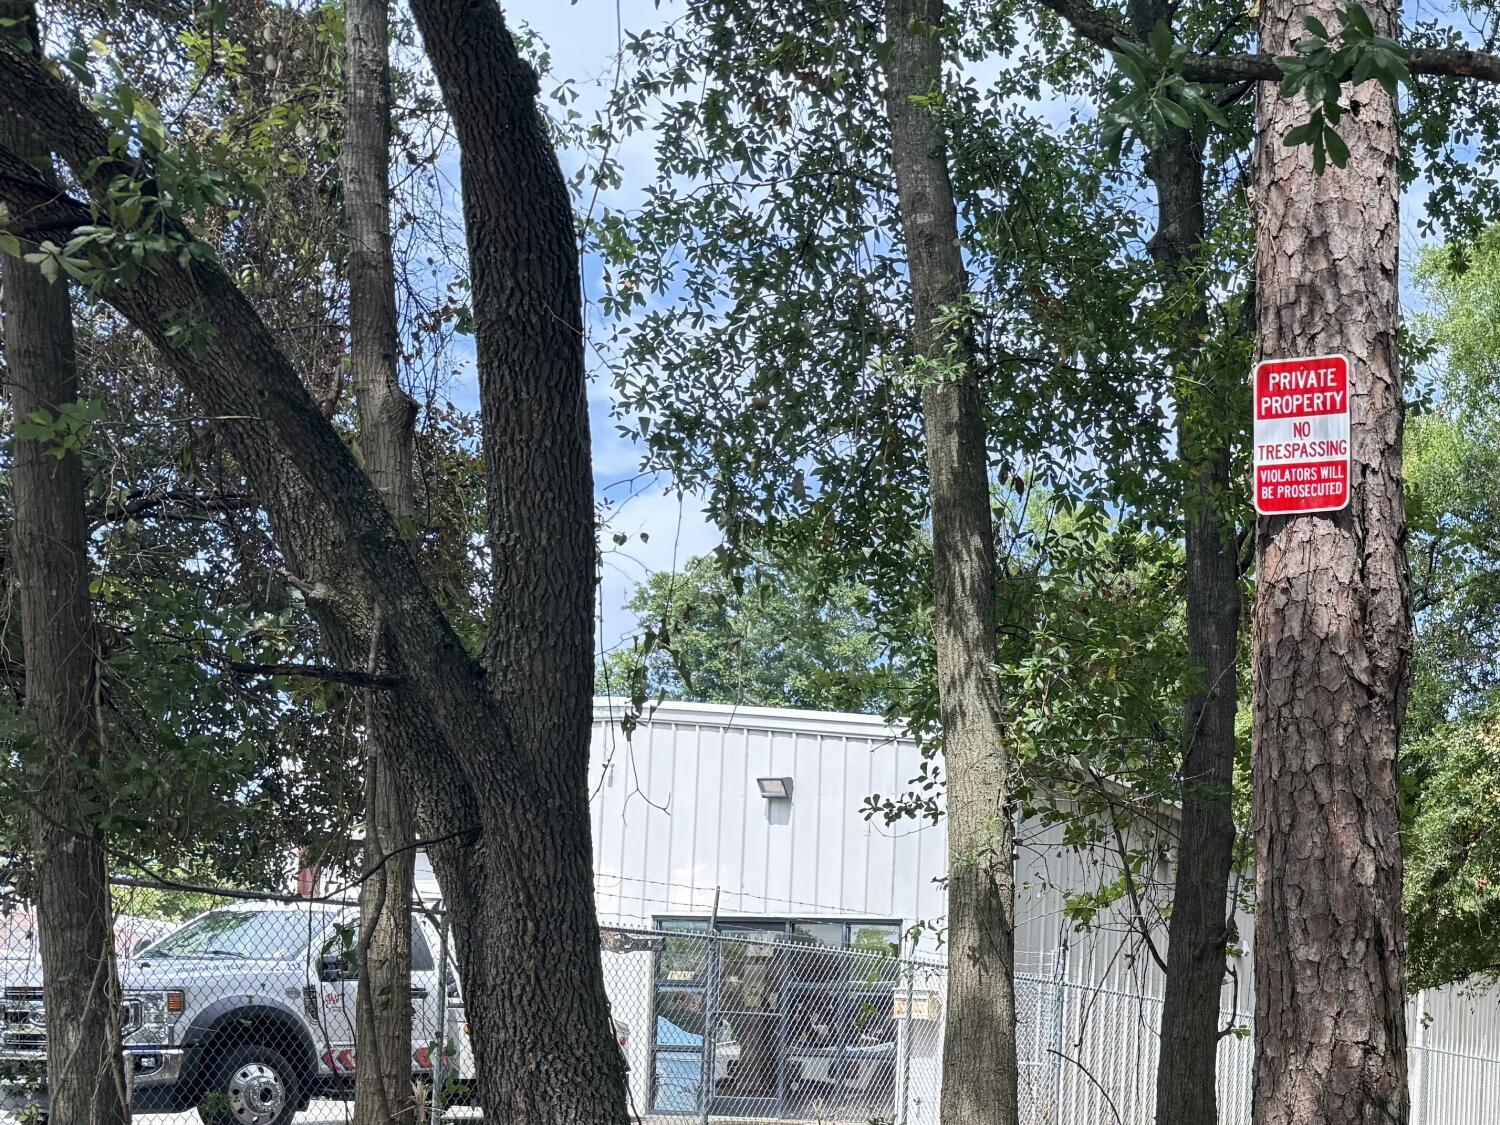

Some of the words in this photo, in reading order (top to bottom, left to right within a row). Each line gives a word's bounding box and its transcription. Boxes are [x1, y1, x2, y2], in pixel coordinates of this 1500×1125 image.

[1268, 368, 1337, 392] PRIVATE
[1261, 391, 1344, 416] PROPERTY
[1293, 421, 1311, 438] NO
[1258, 439, 1348, 461] TRESPASSING
[1260, 467, 1317, 483] VIOLATORS
[1320, 465, 1344, 480] WILL
[1261, 485, 1275, 499] BE
[1277, 481, 1343, 499] PROSECUTED
